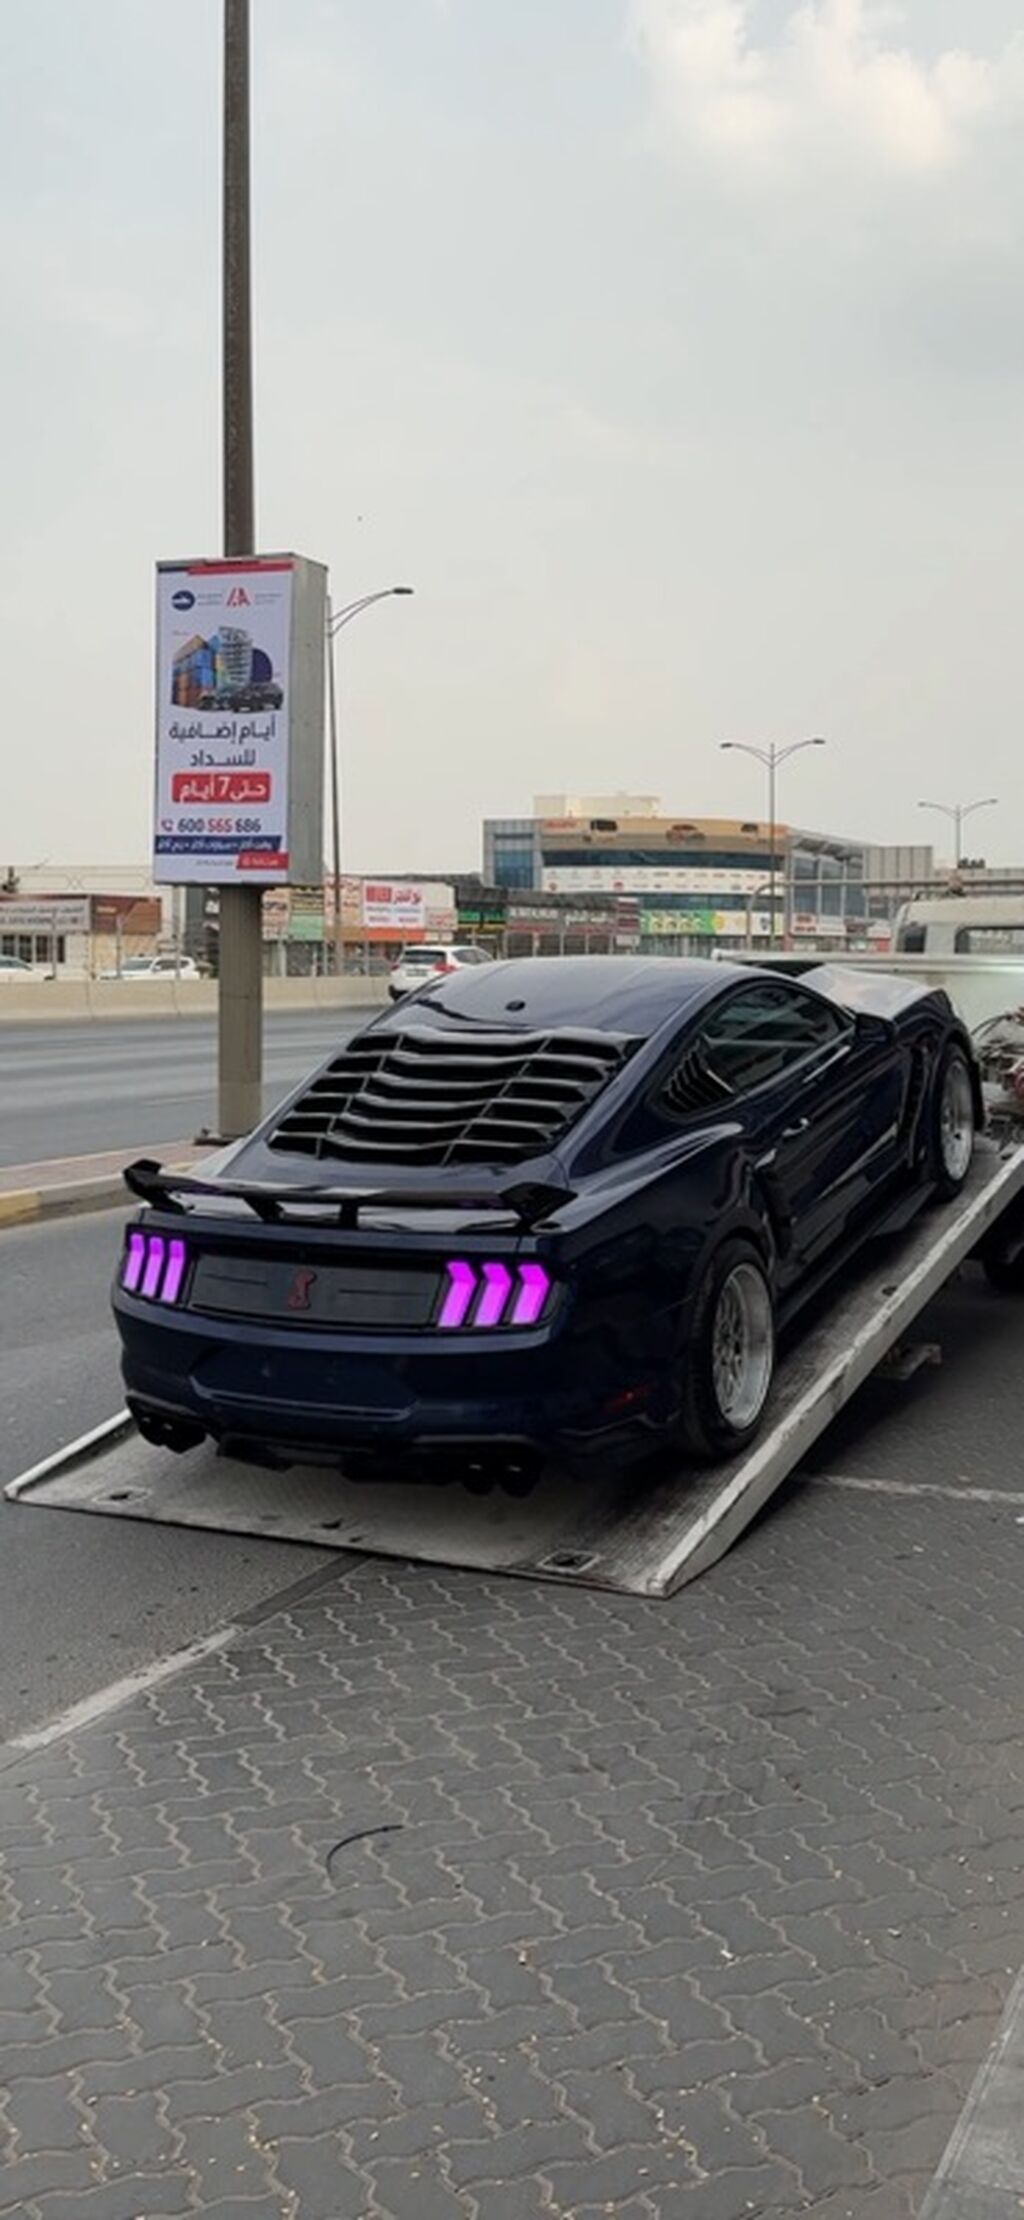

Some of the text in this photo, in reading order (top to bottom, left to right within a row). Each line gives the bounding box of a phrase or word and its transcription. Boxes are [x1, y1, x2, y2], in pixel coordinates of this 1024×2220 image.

[240, 714, 275, 744] أيام
[179, 774, 267, 803] حتى 7 أيام
[177, 818, 205, 833] 600
